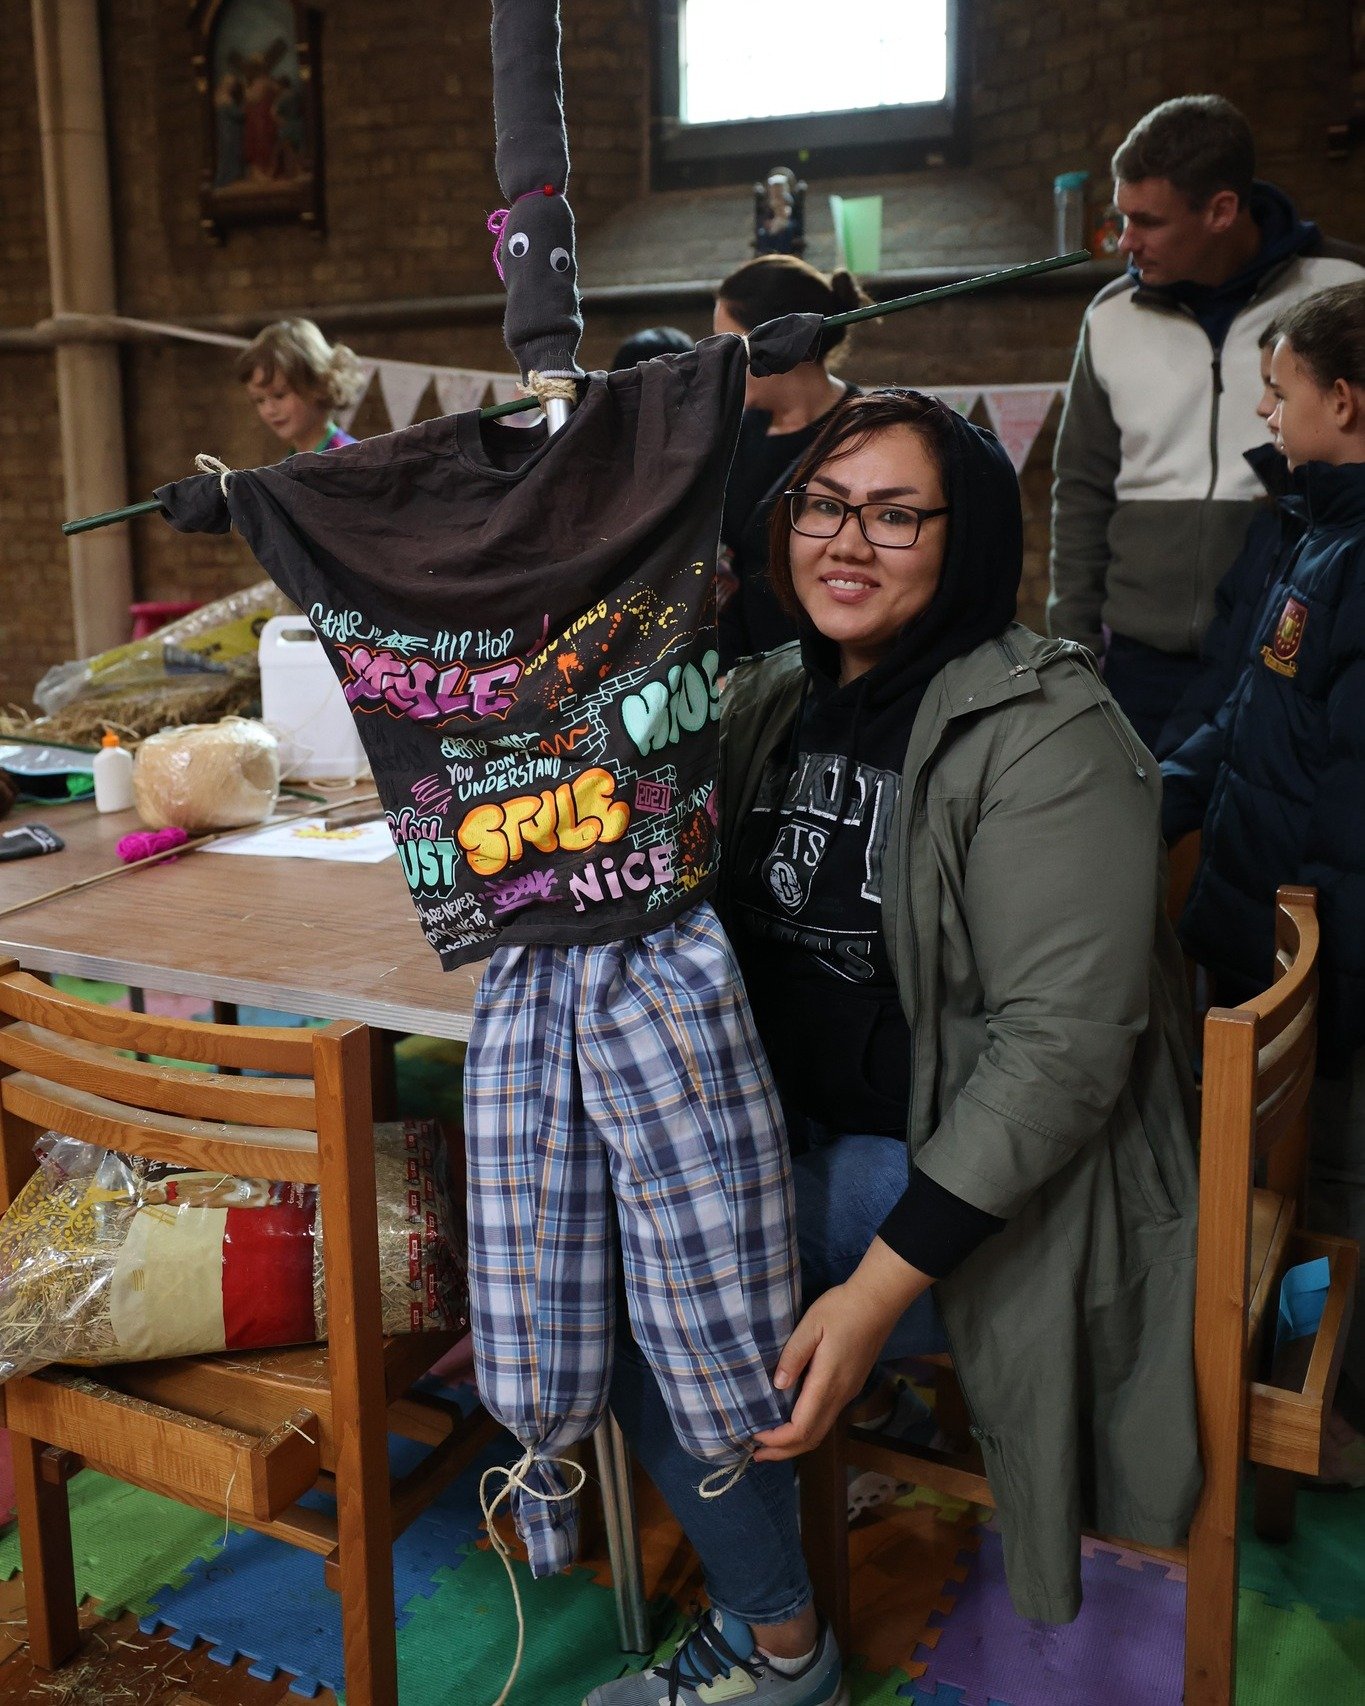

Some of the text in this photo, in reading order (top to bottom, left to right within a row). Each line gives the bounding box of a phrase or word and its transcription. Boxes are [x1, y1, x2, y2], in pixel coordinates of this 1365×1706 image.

[431, 630, 472, 662] HIP
[475, 628, 514, 660] HOP
[445, 749, 531, 785] YOU DON'T
[458, 757, 561, 801] UNDERSTAND
[638, 784, 669, 811] 2021
[441, 893, 481, 921] NEVER
